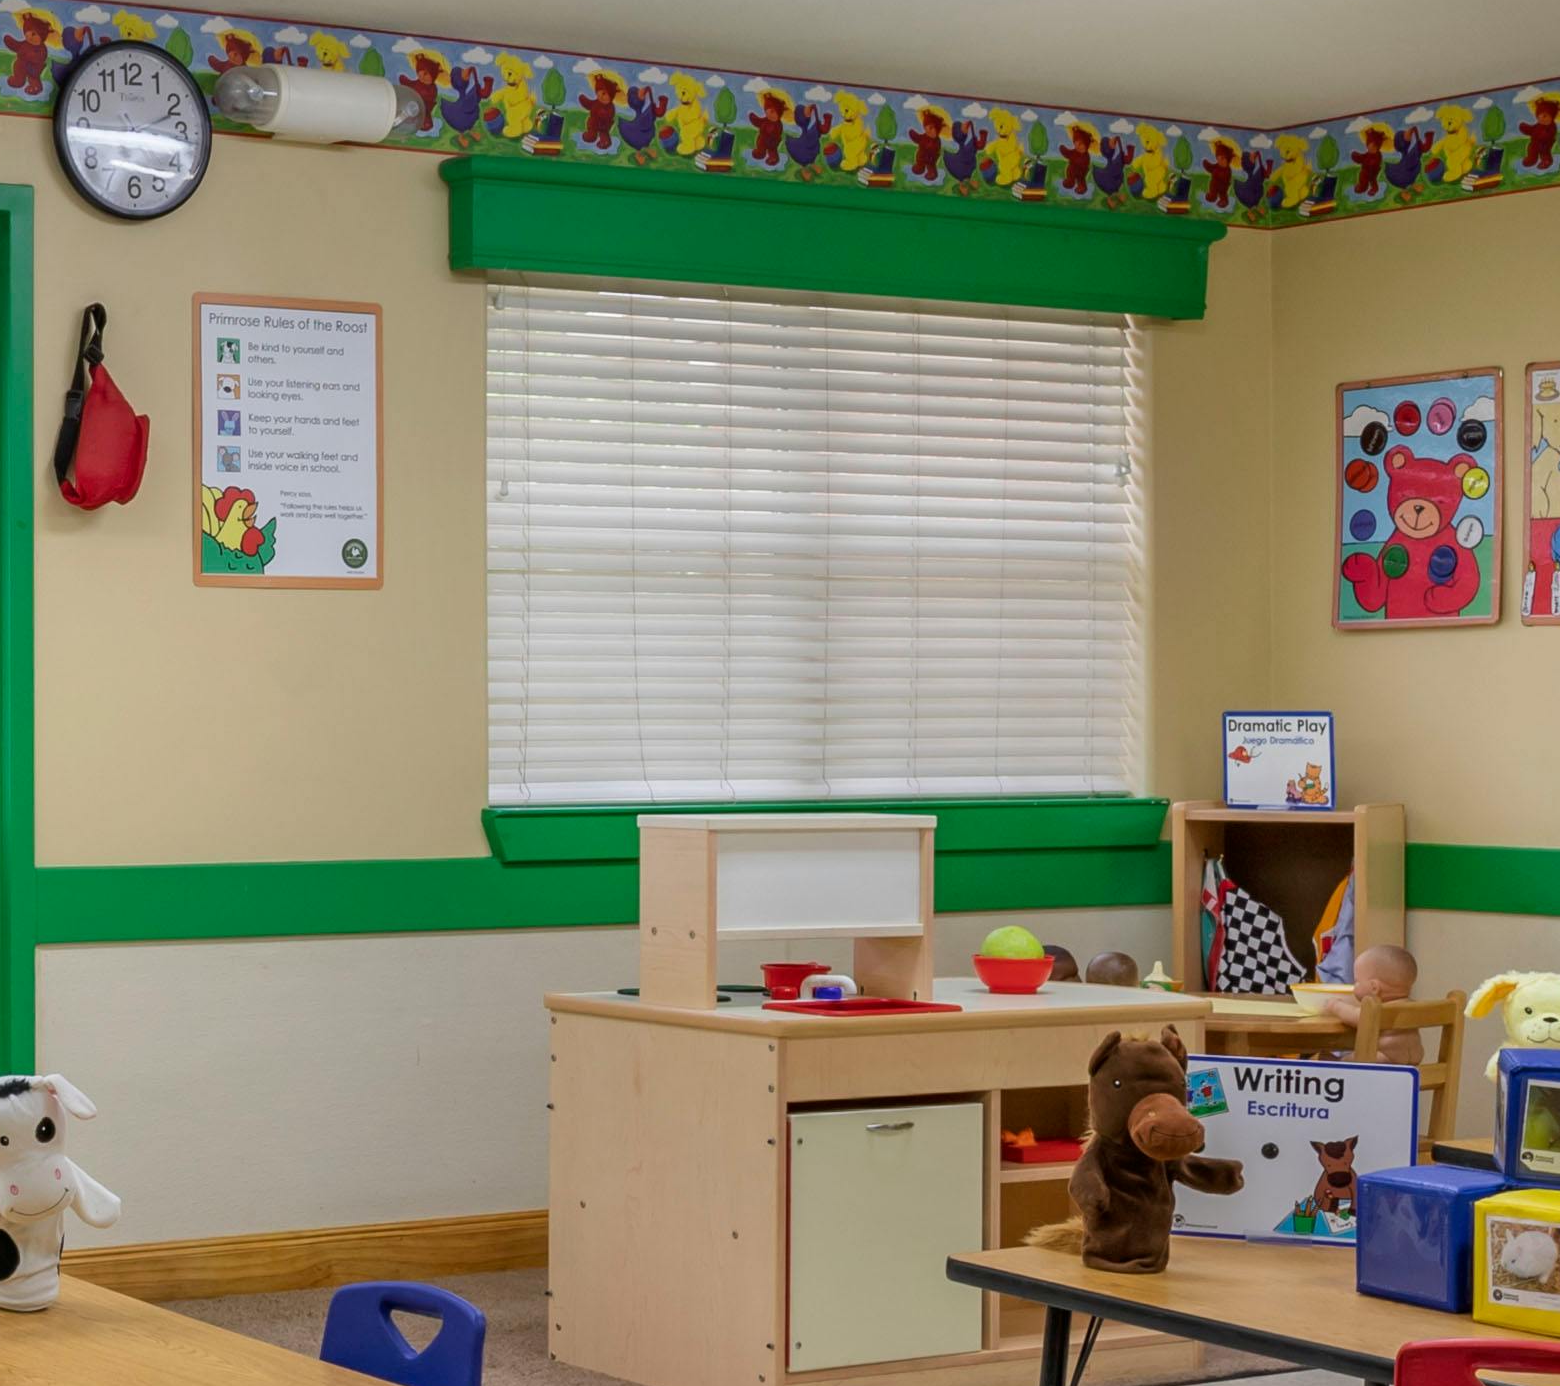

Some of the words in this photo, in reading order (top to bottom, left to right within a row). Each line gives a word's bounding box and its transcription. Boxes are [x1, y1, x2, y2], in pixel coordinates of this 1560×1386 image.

[97, 68, 116, 93] 11
[119, 62, 143, 87] 12
[151, 71, 161, 95] 1
[77, 89, 101, 113] 10
[166, 92, 182, 117] 2
[174, 121, 188, 143] 3
[84, 145, 98, 170] 8
[168, 152, 181, 173] 4
[101, 167, 117, 191] 7
[127, 175, 142, 200] 6
[208, 312, 261, 328] Primrose
[264, 316, 295, 329] Rules
[297, 318, 310, 330] of
[313, 319, 333, 331] the
[335, 320, 368, 334] Roost
[247, 341, 260, 351] Be
[261, 342, 280, 353] kind
[281, 344, 291, 354] to
[292, 344, 325, 357] yourself
[326, 346, 345, 357] and
[247, 355, 277, 364] others.
[247, 377, 263, 387] Use
[265, 379, 284, 389] your
[286, 379, 321, 391] listening
[322, 382, 341, 391] ears
[342, 383, 361, 392] and
[247, 390, 280, 401] looking
[248, 413, 272, 424] Keep
[273, 414, 293, 425] your
[294, 415, 321, 425] hands
[322, 416, 341, 426] and
[342, 417, 360, 427] feet
[248, 426, 258, 435] to
[247, 461, 273, 471] inside
[274, 462, 299, 472] voice
[300, 462, 309, 472] in
[248, 449, 264, 459] Use
[265, 451, 284, 460] your
[286, 452, 320, 463] walking
[321, 452, 339, 462] feet
[340, 453, 359, 463] and
[1228, 719, 1292, 733] Dramatic
[1297, 719, 1327, 736] Play
[1242, 736, 1268, 747] Juego
[1233, 1065, 1345, 1105] Writing
[1246, 1099, 1330, 1121] Escritura
